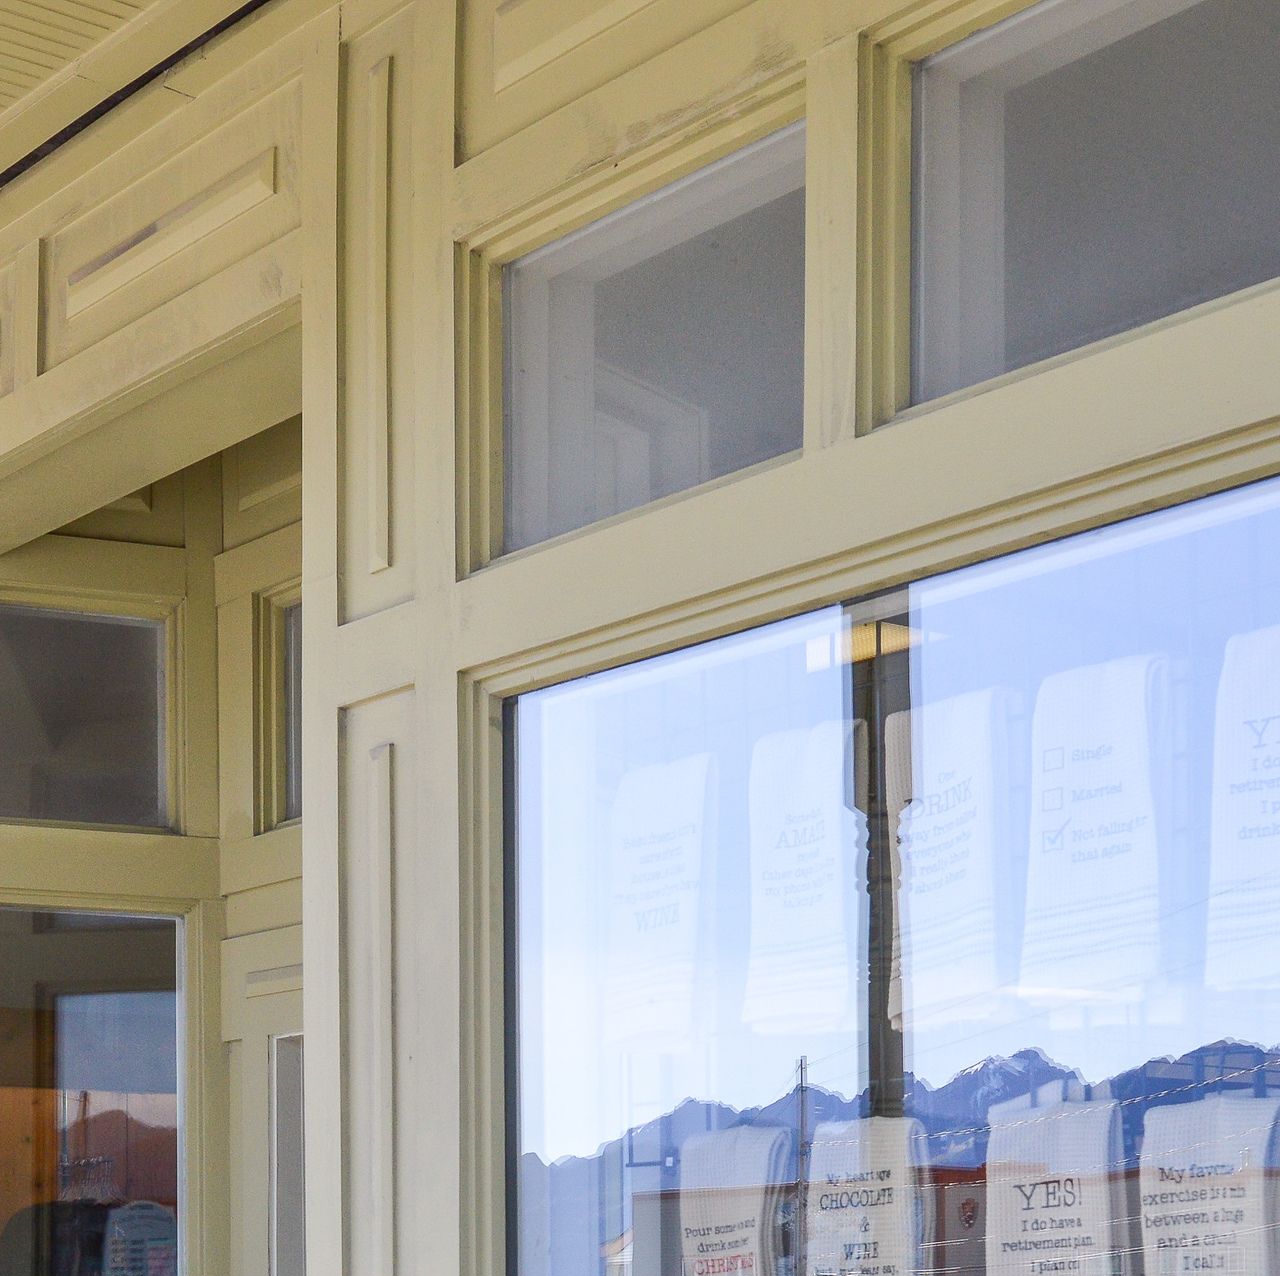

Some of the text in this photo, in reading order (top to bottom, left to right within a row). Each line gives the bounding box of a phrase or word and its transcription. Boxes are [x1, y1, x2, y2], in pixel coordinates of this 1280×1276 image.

[1072, 744, 1113, 761] Single
[1251, 758, 1258, 771] I
[904, 776, 973, 819] DRINK
[1072, 780, 1122, 802] Married
[1260, 799, 1269, 813] I
[1072, 819, 1134, 842] Not falling
[1071, 848, 1099, 862] that
[846, 1171, 873, 1182] heart
[1159, 1167, 1185, 1183] My
[820, 1187, 894, 1210] CHOCOLATE
[1013, 1178, 1082, 1211] YES!
[1143, 1189, 1207, 1206] exercise
[859, 1216, 870, 1232] &
[1022, 1218, 1074, 1232] I do have
[1145, 1212, 1210, 1229] between
[685, 1227, 712, 1238] Pour
[698, 1241, 730, 1253] drink
[1002, 1238, 1072, 1252] retirement
[1157, 1234, 1188, 1249] and
[843, 1242, 879, 1260] WINE
[1039, 1261, 1065, 1274] plan
[1193, 1255, 1215, 1268] call
